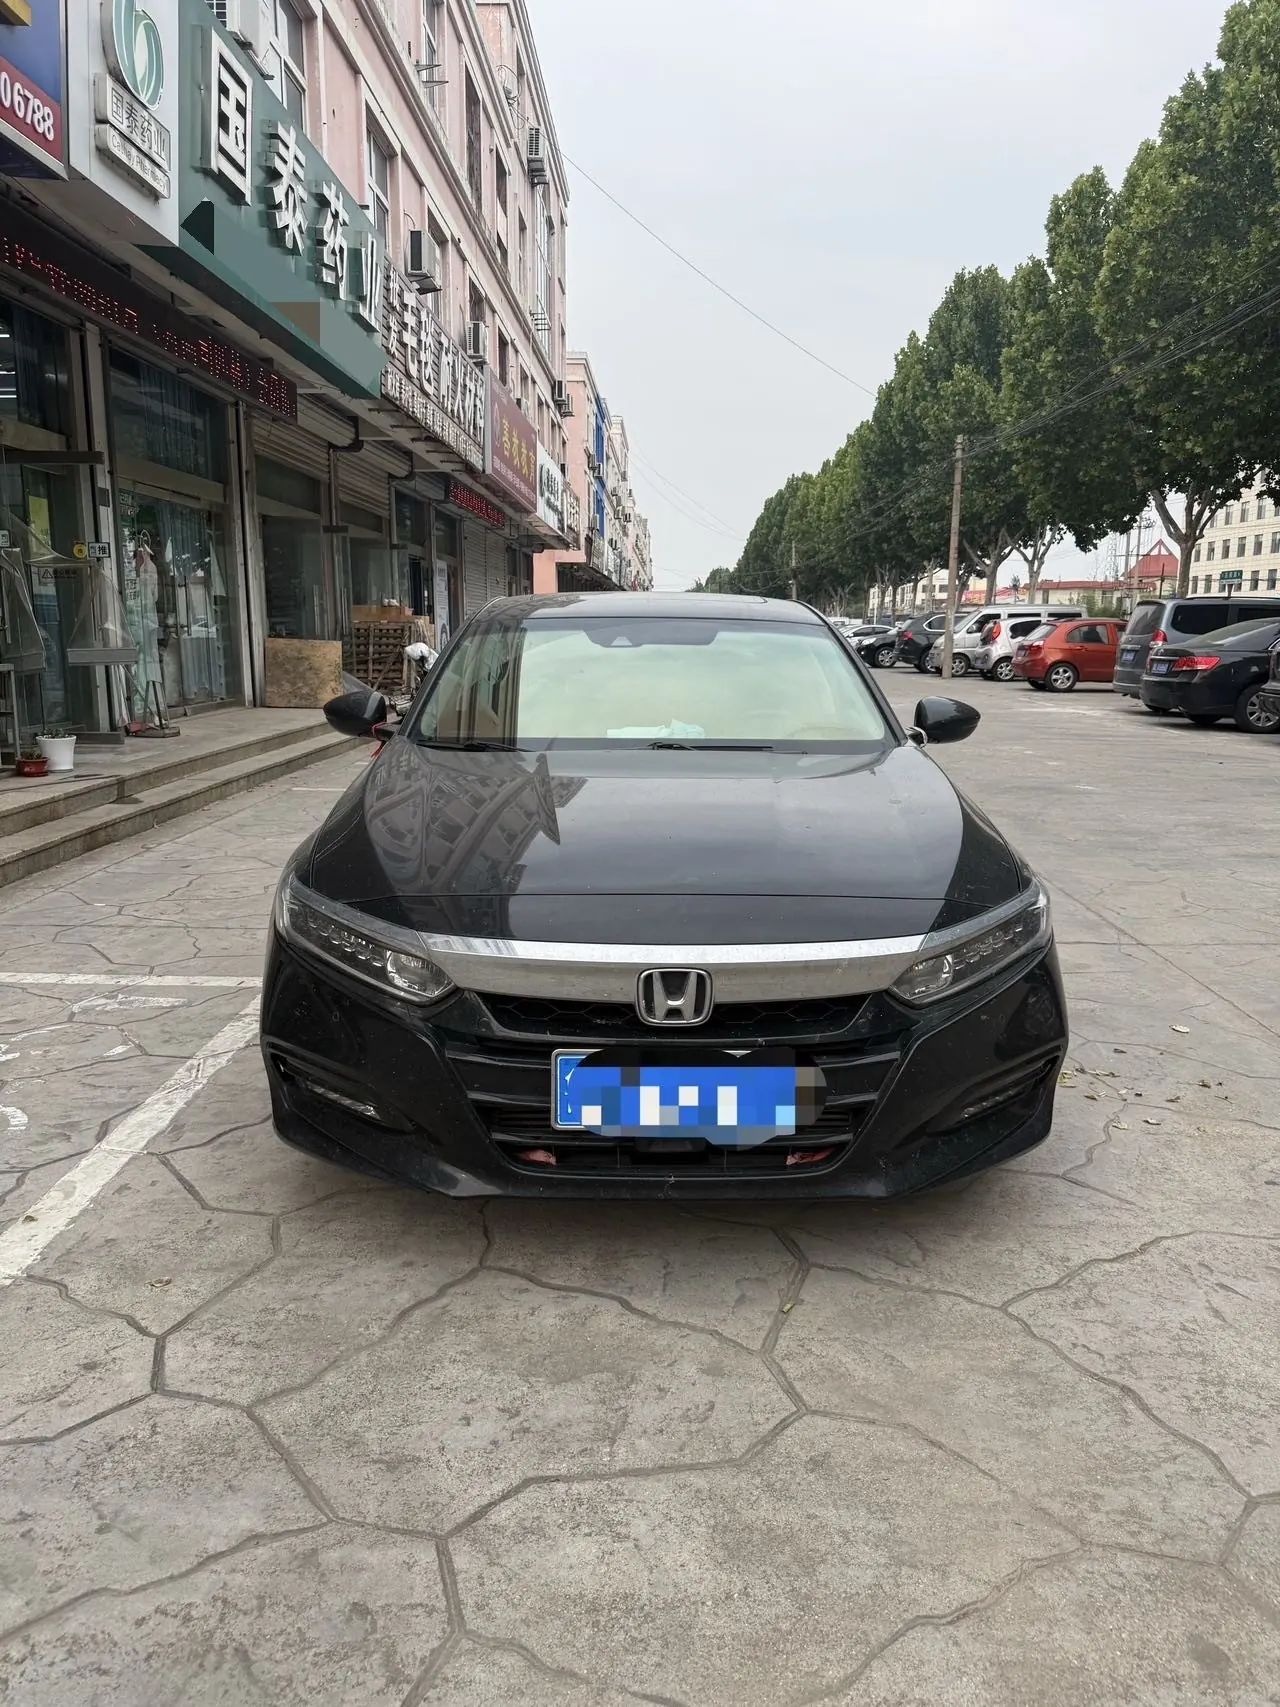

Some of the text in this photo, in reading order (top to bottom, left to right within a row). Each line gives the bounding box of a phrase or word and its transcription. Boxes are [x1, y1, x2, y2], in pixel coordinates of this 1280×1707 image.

[0, 71, 55, 142] 06788
[112, 88, 166, 161] 国泰药业
[209, 31, 381, 331] 国泰药业
[389, 264, 401, 361] 批发
[98, 545, 108, 555] 推
